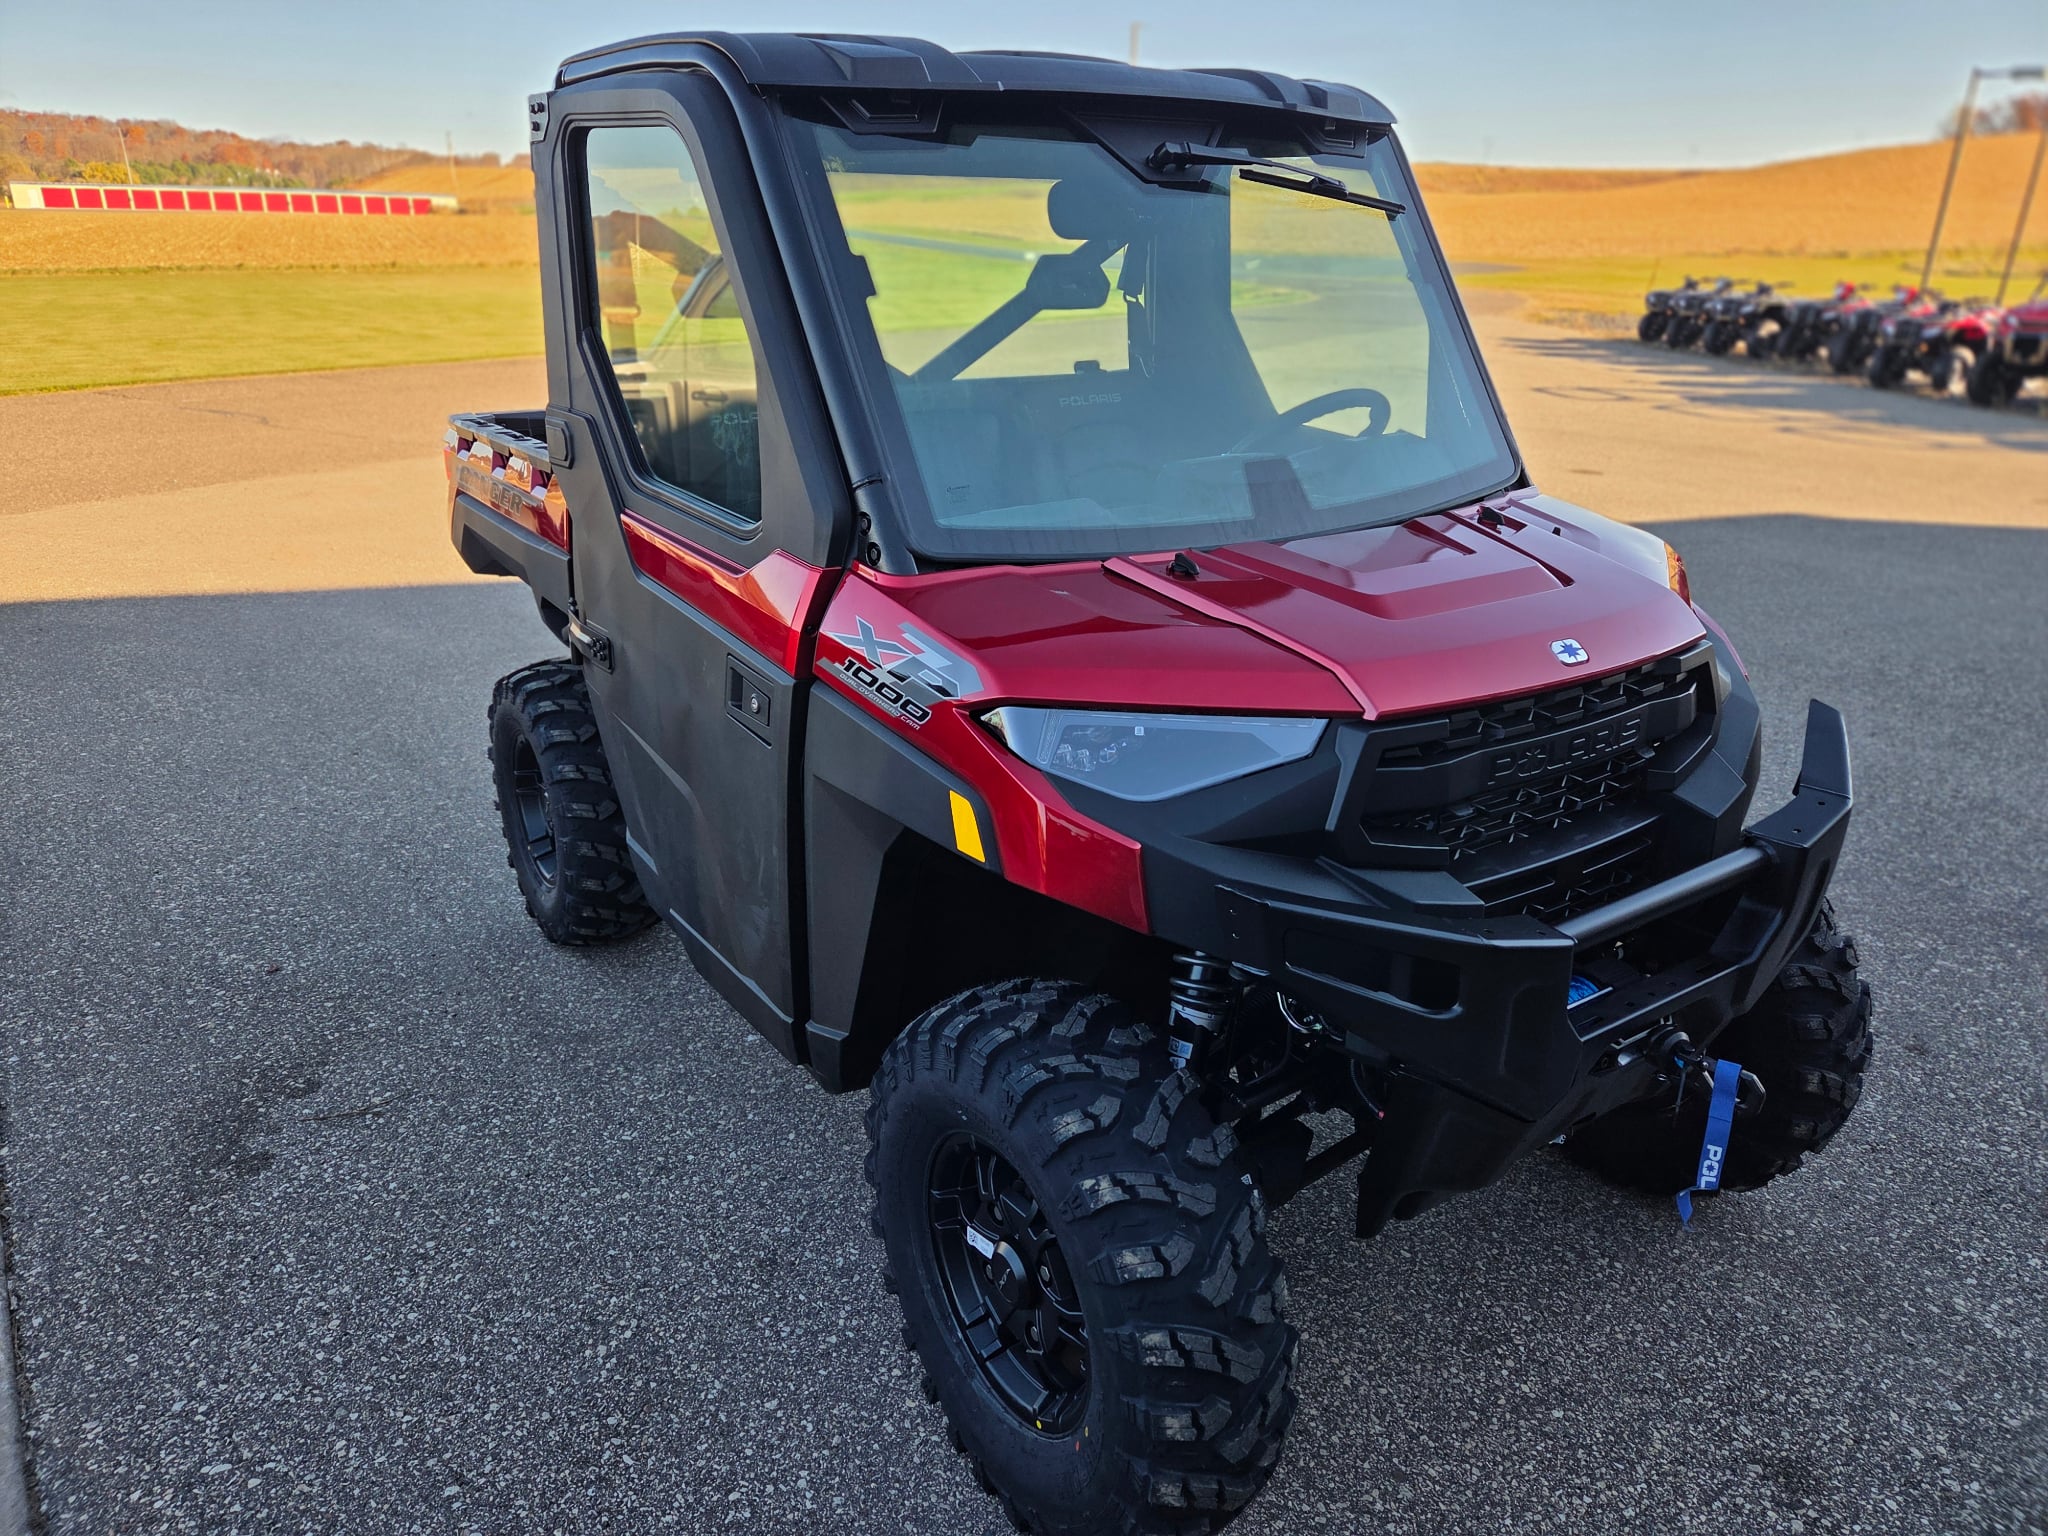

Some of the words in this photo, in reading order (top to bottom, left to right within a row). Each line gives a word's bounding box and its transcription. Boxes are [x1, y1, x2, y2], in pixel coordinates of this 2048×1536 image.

[1059, 393, 1122, 408] POLARIS
[458, 466, 523, 516] RANGER
[825, 615, 961, 700] XP
[839, 673, 859, 690] DUAL
[858, 686, 901, 717] OVERHEAD
[900, 715, 921, 731] CAM
[843, 657, 932, 726] 1000
[1488, 718, 1641, 785] POLARIS
[1700, 1144, 1723, 1189] POL
